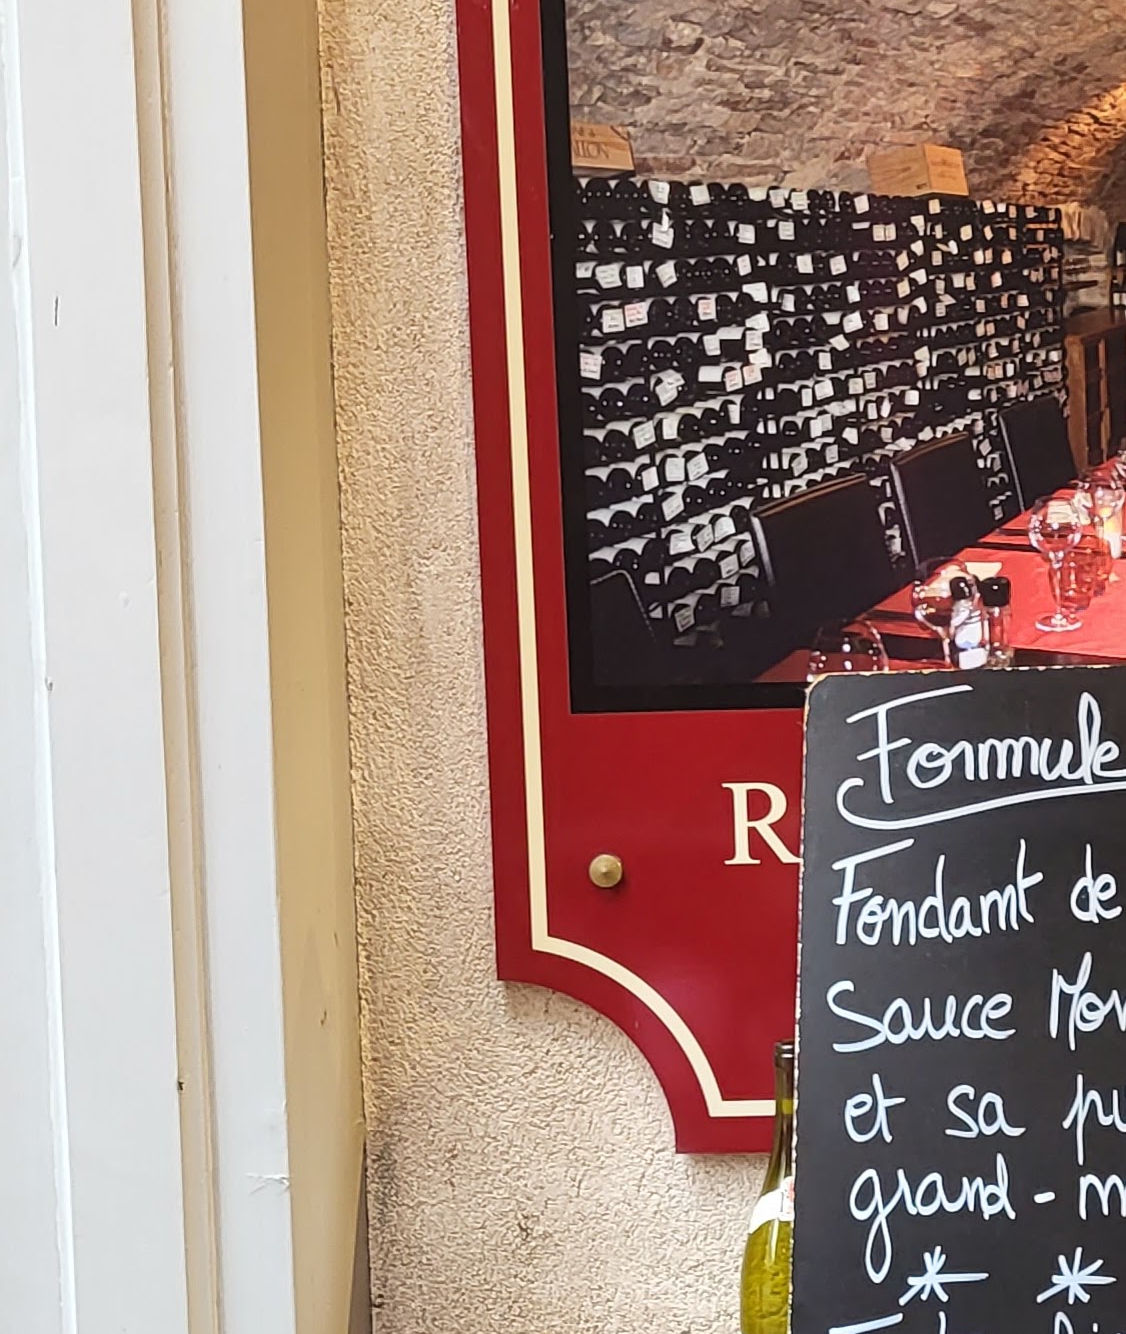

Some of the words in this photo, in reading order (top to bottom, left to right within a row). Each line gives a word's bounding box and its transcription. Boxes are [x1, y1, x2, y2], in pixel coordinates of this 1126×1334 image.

[831, 840, 1042, 946] Fondant
[1069, 844, 1123, 923] de
[827, 980, 1016, 1053] Sauce
[843, 1073, 905, 1144] et
[946, 1083, 1025, 1138] sa
